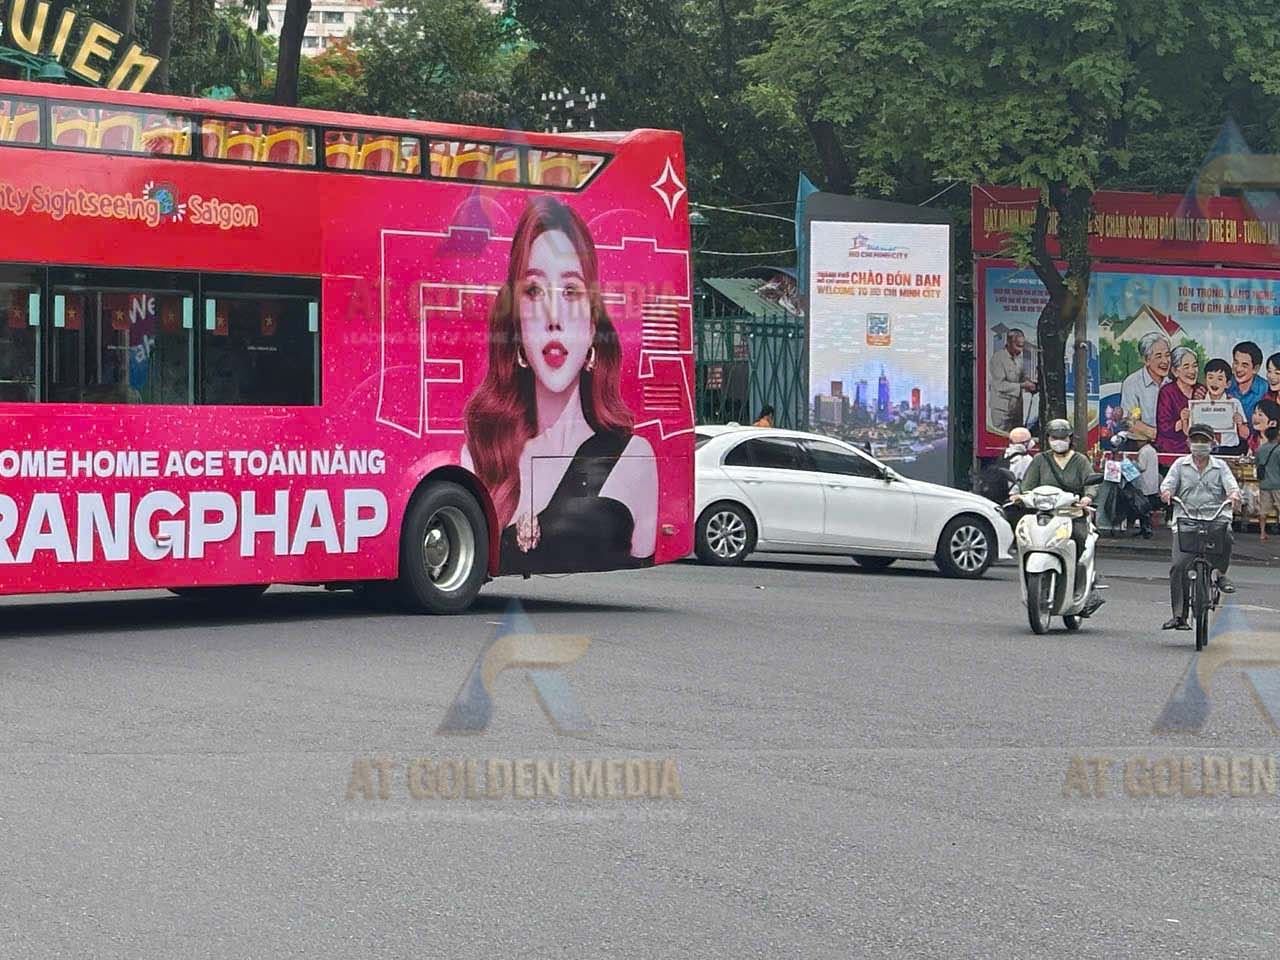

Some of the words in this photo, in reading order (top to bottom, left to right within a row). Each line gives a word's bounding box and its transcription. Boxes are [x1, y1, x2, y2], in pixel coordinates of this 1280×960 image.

[31, 184, 161, 227] Sightseeing
[188, 194, 259, 230] Saigon
[817, 285, 855, 296] WELCOME
[858, 286, 867, 296] TO
[900, 289, 921, 297] MINH
[923, 289, 941, 298] CITY
[71, 450, 158, 477] HOME
[163, 449, 224, 477] ACE
[230, 444, 307, 477] TOÀN
[310, 444, 386, 475] NĂNG
